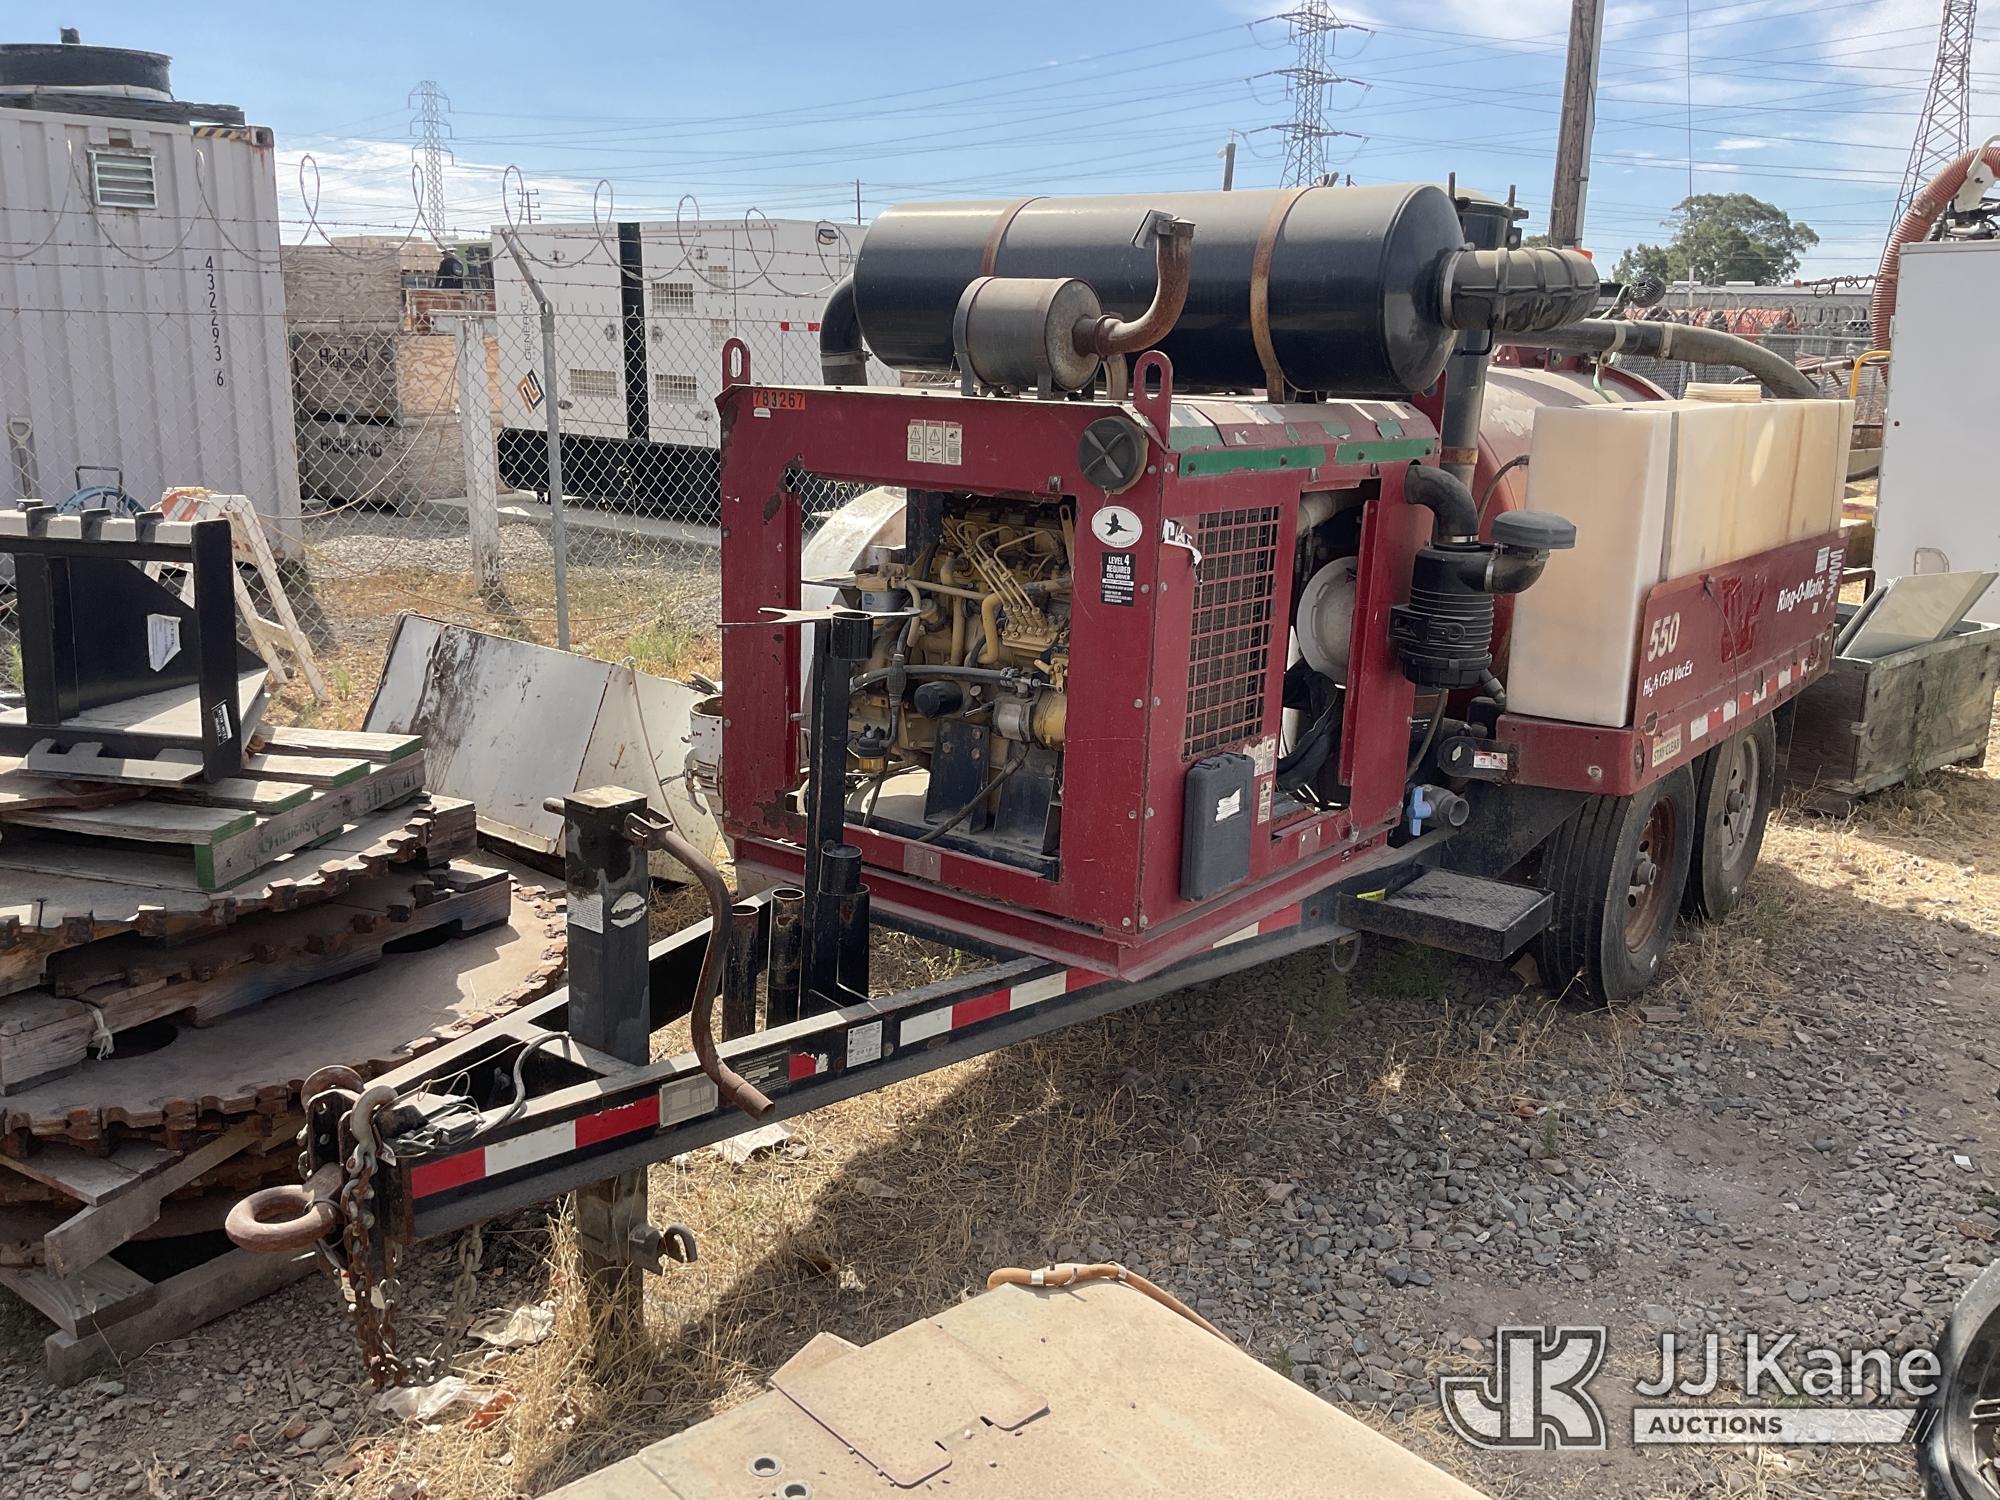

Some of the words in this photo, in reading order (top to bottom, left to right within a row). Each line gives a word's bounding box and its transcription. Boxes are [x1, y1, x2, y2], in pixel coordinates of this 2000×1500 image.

[753, 390, 804, 408] 783267
[1106, 564, 1131, 574] REQUIRED
[1108, 556, 1123, 565] LEVEL
[1124, 554, 1130, 566] 4
[1776, 575, 1825, 613] Ring-O-Matic
[1647, 611, 1681, 662] 550
[1642, 673, 1659, 697] High
[1659, 668, 1674, 687] CFM
[1653, 748, 1665, 762] STAY
[1665, 738, 1680, 755] CLEAR
